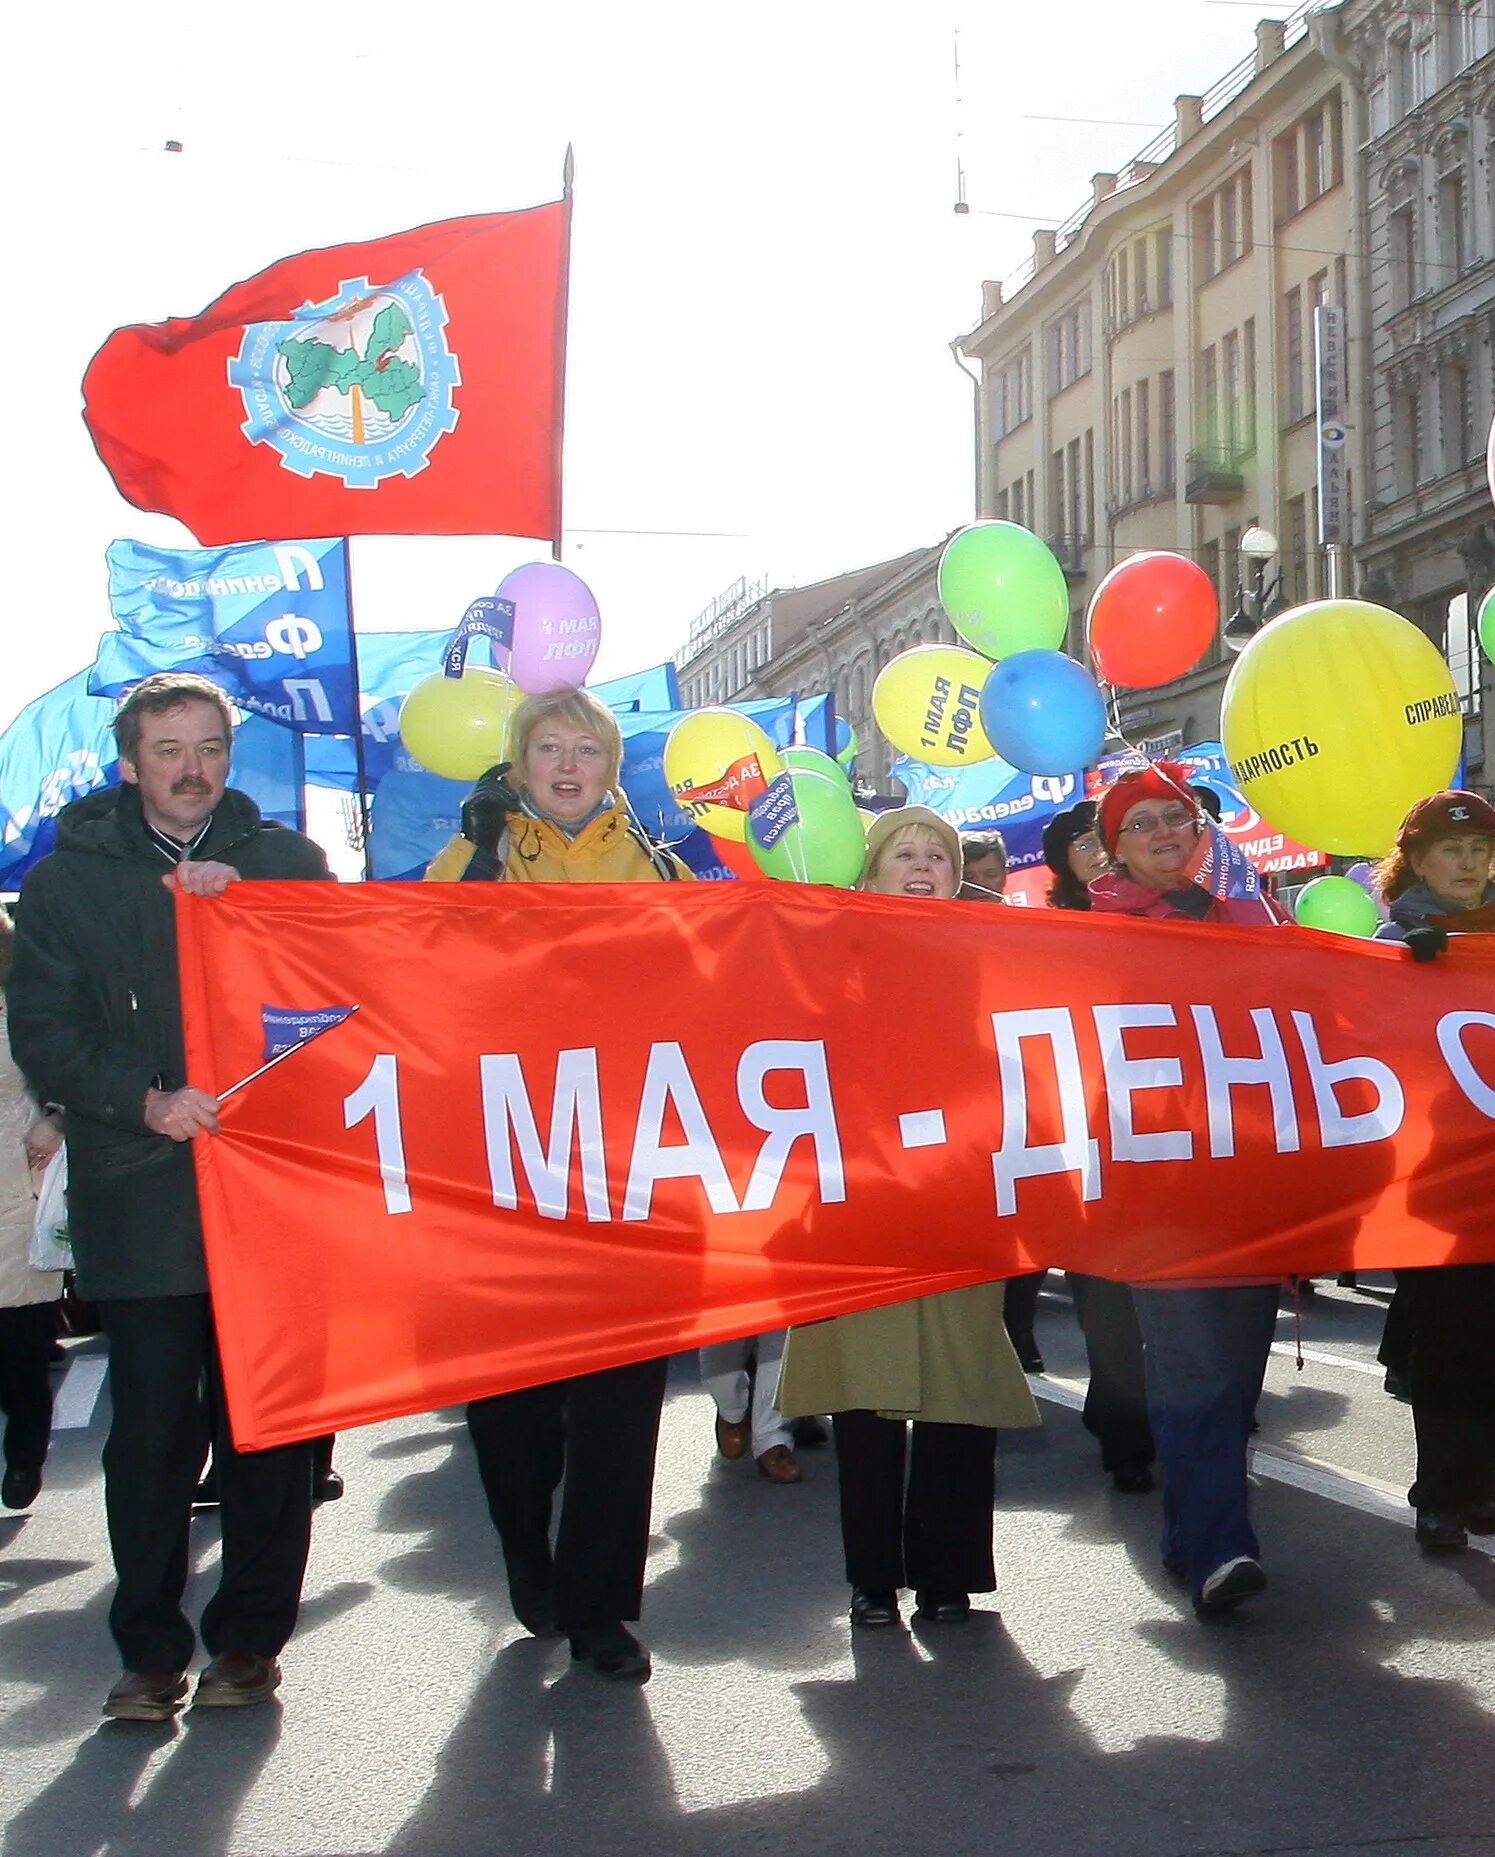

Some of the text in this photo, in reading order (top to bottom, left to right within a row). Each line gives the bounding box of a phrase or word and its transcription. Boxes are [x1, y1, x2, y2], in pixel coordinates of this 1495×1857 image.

[559, 616, 597, 635] МАЯ
[920, 676, 951, 748] 1 МАЯ
[946, 684, 981, 755] ЛФП
[343, 1054, 413, 1216] 1
[479, 1038, 846, 1224] МАЯ
[899, 1109, 948, 1149] -
[991, 1003, 1406, 1218] ДЕНЬ
